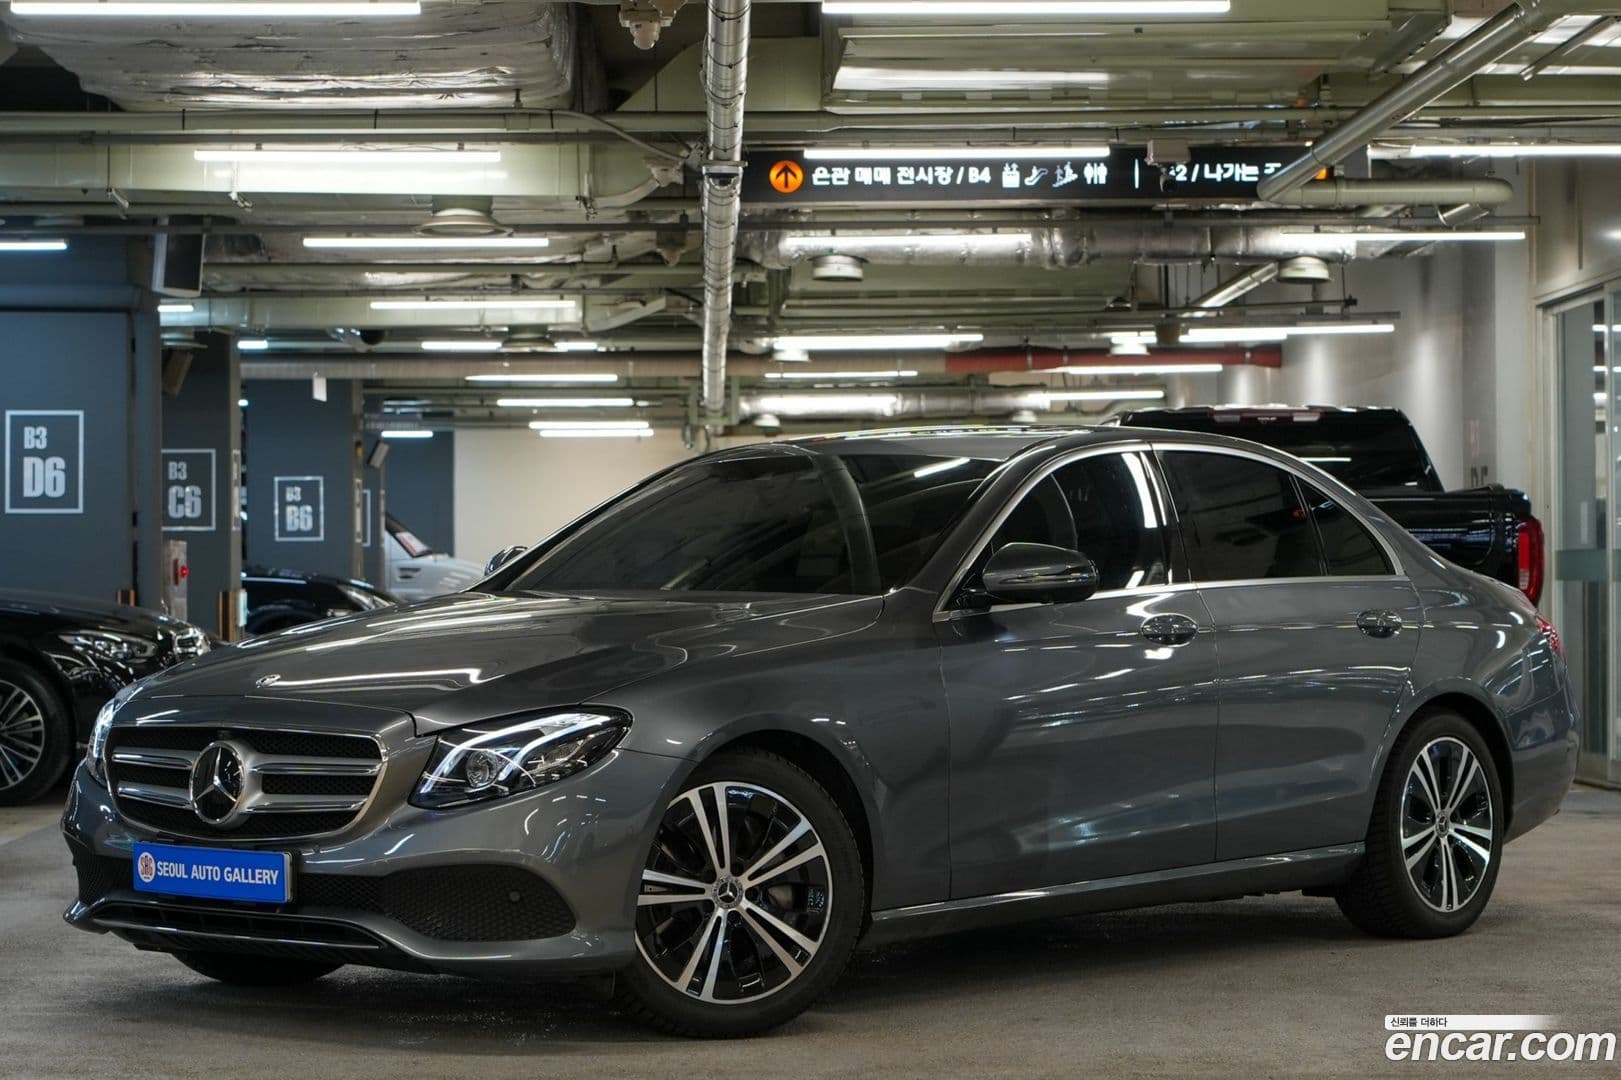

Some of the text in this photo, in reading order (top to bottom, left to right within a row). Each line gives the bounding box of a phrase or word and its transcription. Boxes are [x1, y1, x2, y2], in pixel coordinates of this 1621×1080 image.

[854, 166, 891, 185] 매매
[896, 166, 954, 186] 전시장
[968, 166, 992, 184] B4
[1204, 163, 1259, 182] 나가는
[23, 426, 47, 450] B3
[23, 456, 66, 498] D6
[168, 461, 187, 481] B3
[167, 485, 202, 519] C6
[285, 486, 301, 502] B3
[285, 505, 313, 532] B6
[157, 860, 279, 885] SEOUL AUTO GALLERY
